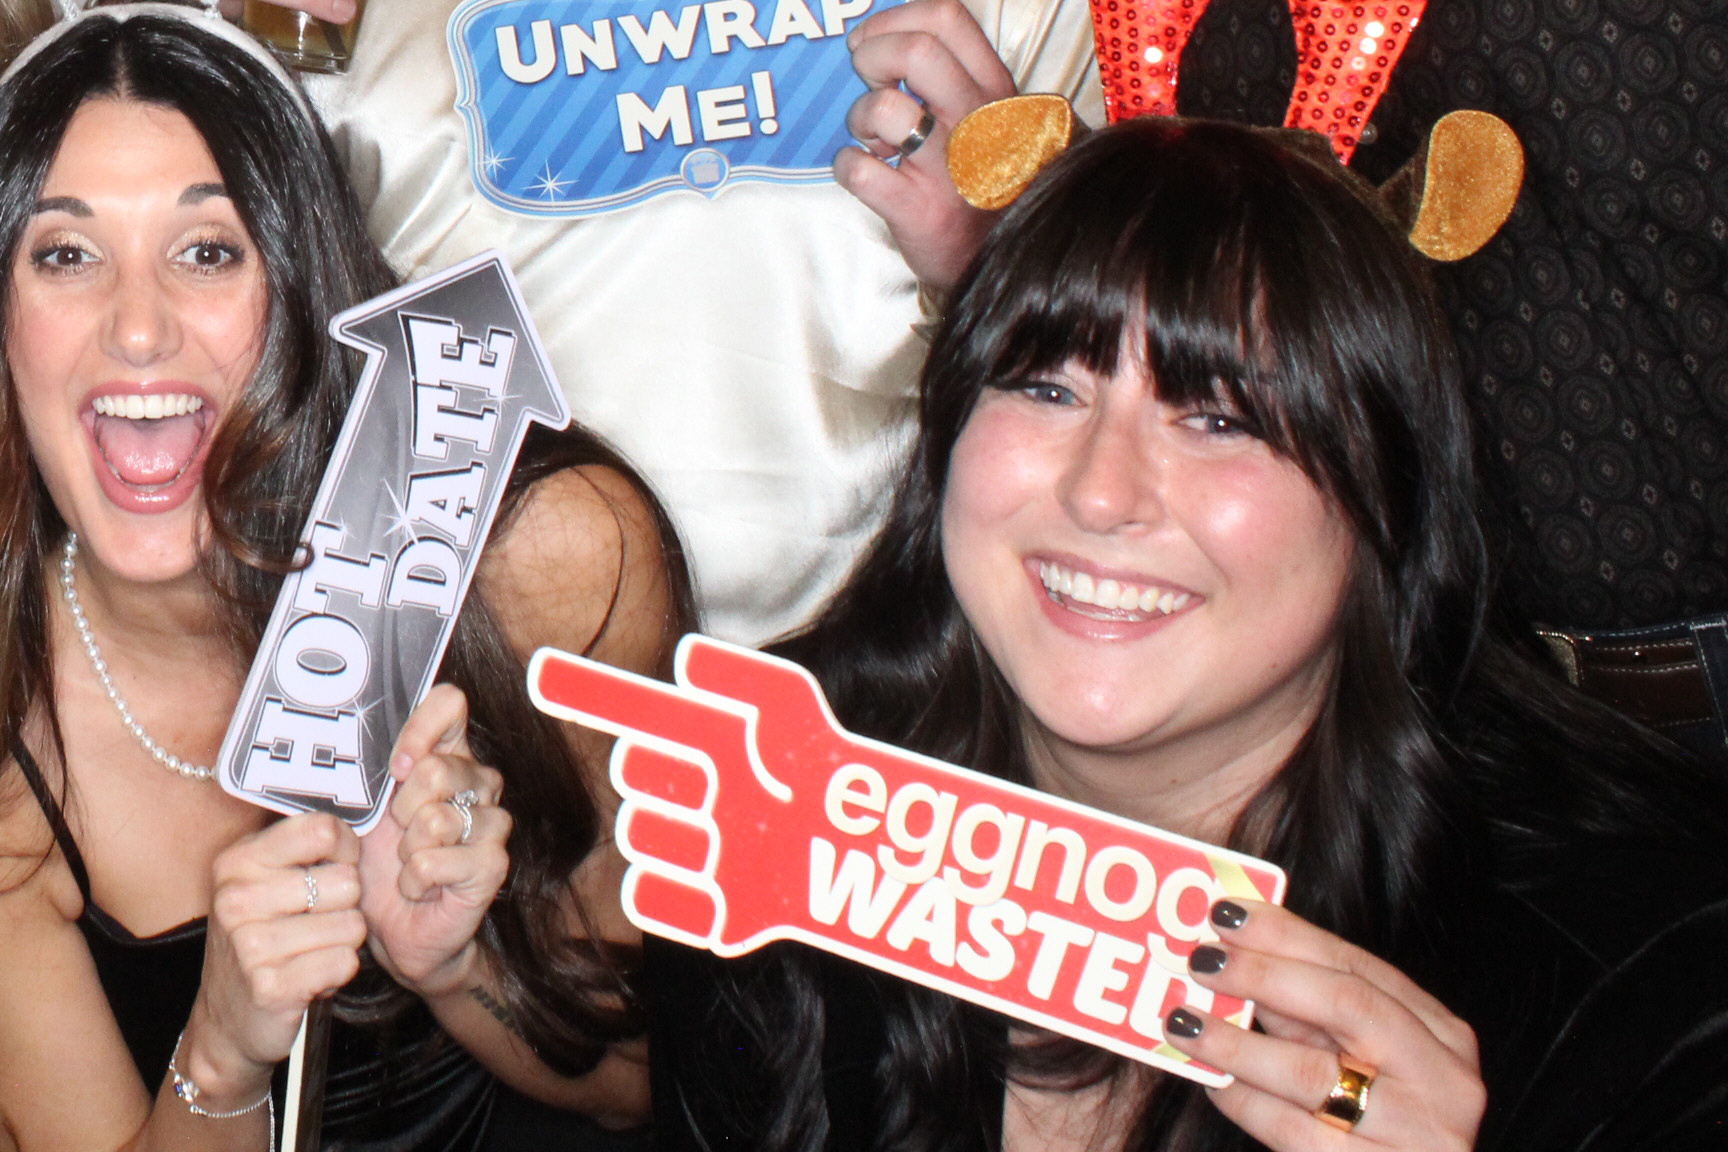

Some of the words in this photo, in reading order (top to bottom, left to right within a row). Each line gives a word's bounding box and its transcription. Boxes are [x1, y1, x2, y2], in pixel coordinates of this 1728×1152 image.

[615, 70, 780, 154] ME!
[385, 311, 517, 617] DATE
[241, 520, 389, 808] HOT
